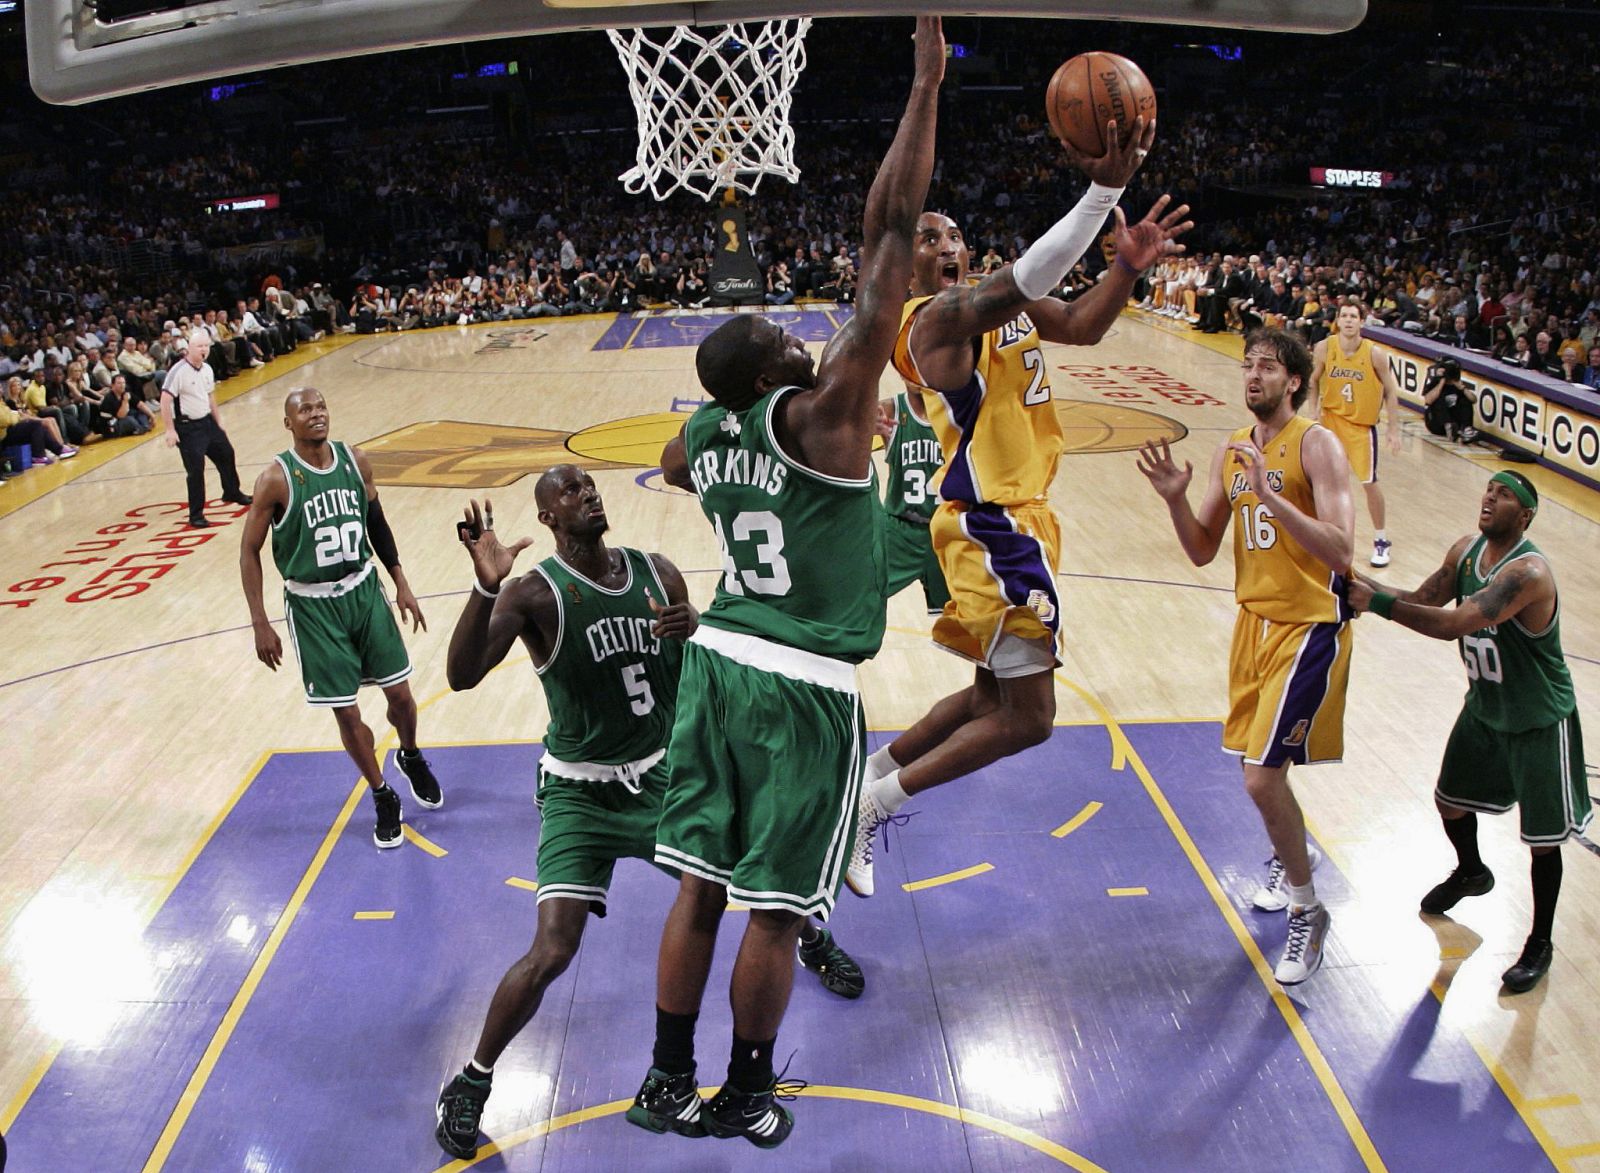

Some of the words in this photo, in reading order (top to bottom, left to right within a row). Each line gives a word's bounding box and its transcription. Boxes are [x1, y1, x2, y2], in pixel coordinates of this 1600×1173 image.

[1325, 168, 1382, 188] STAPLES
[722, 277, 755, 292] Finals
[1057, 364, 1157, 405] Center
[1108, 364, 1227, 406] STAPLES
[1341, 382, 1353, 403] 4
[690, 448, 788, 502] PERKINS
[901, 438, 944, 467] CELTIC
[303, 488, 362, 528] CELTICS
[1241, 502, 1278, 551] 16
[0, 502, 189, 608] Center
[65, 498, 252, 603] STAPLES
[314, 520, 363, 568] 20
[585, 616, 661, 664] CELTICS
[1462, 634, 1503, 685] 50
[621, 661, 656, 717] 5
